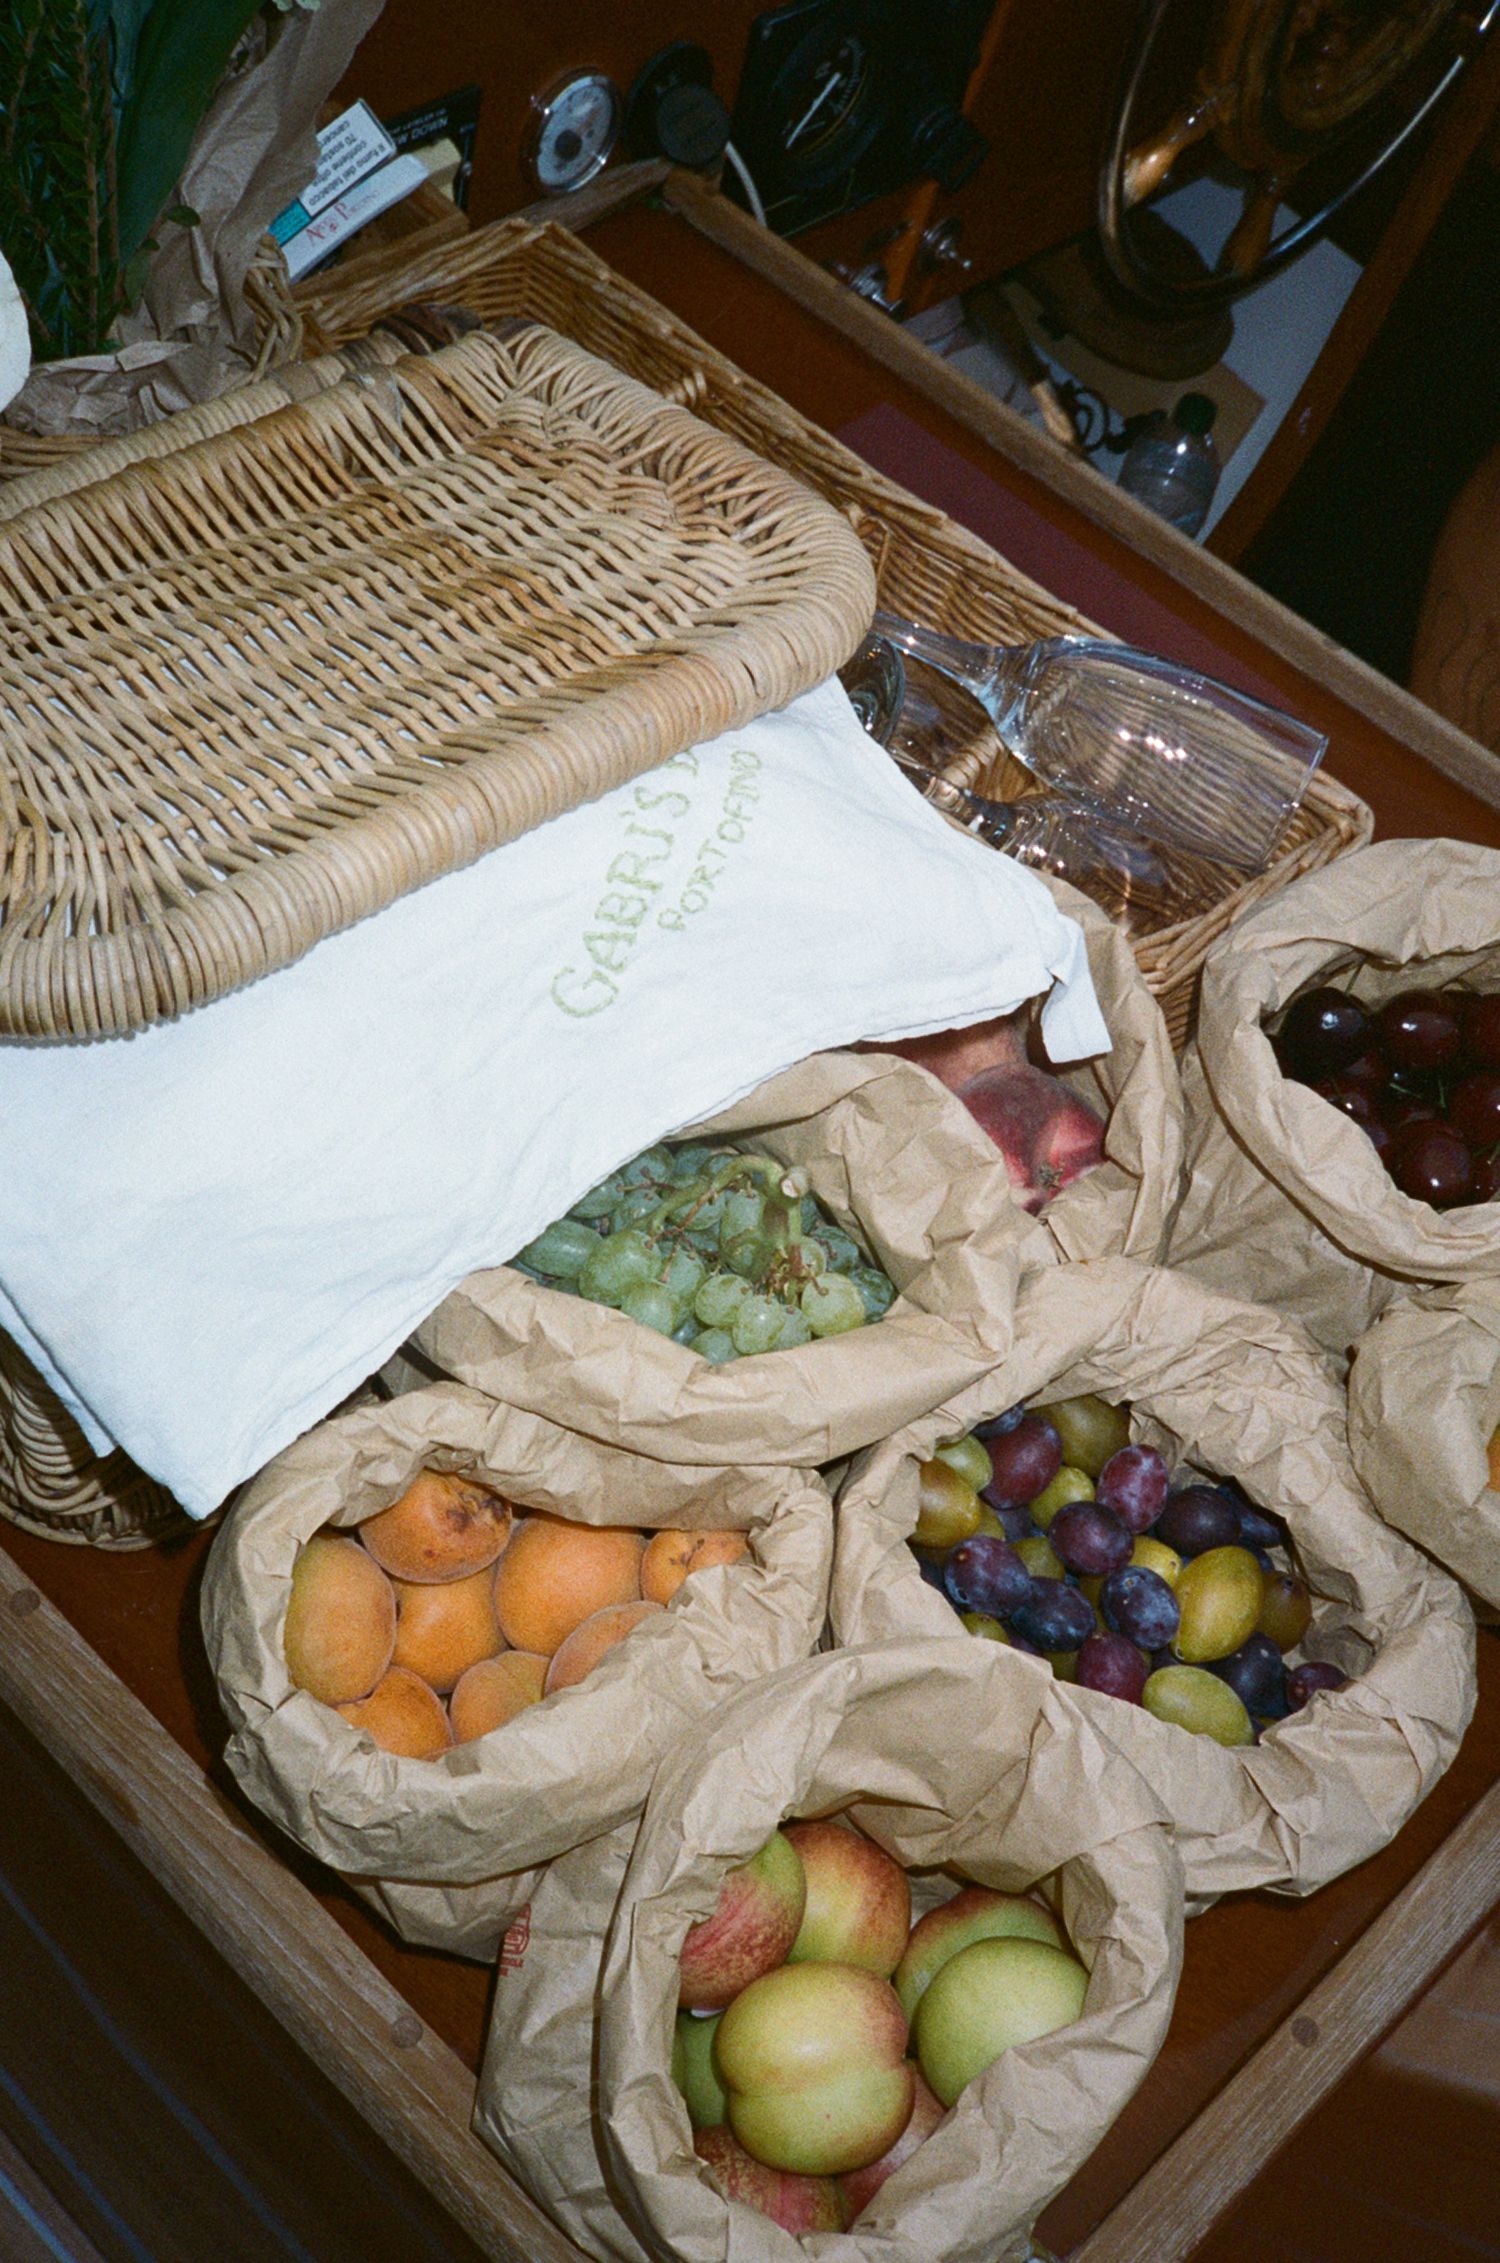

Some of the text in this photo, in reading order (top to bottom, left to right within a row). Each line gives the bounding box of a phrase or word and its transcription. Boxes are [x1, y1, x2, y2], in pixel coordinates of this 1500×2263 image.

[315, 132, 357, 167] 70 sostan
[330, 139, 369, 172] contiene
[355, 148, 379, 169] fumo
[341, 165, 358, 181] del
[307, 176, 344, 207] tabacco
[657, 750, 763, 931] PORTOFINO
[550, 785, 690, 1018] GABRI'S
